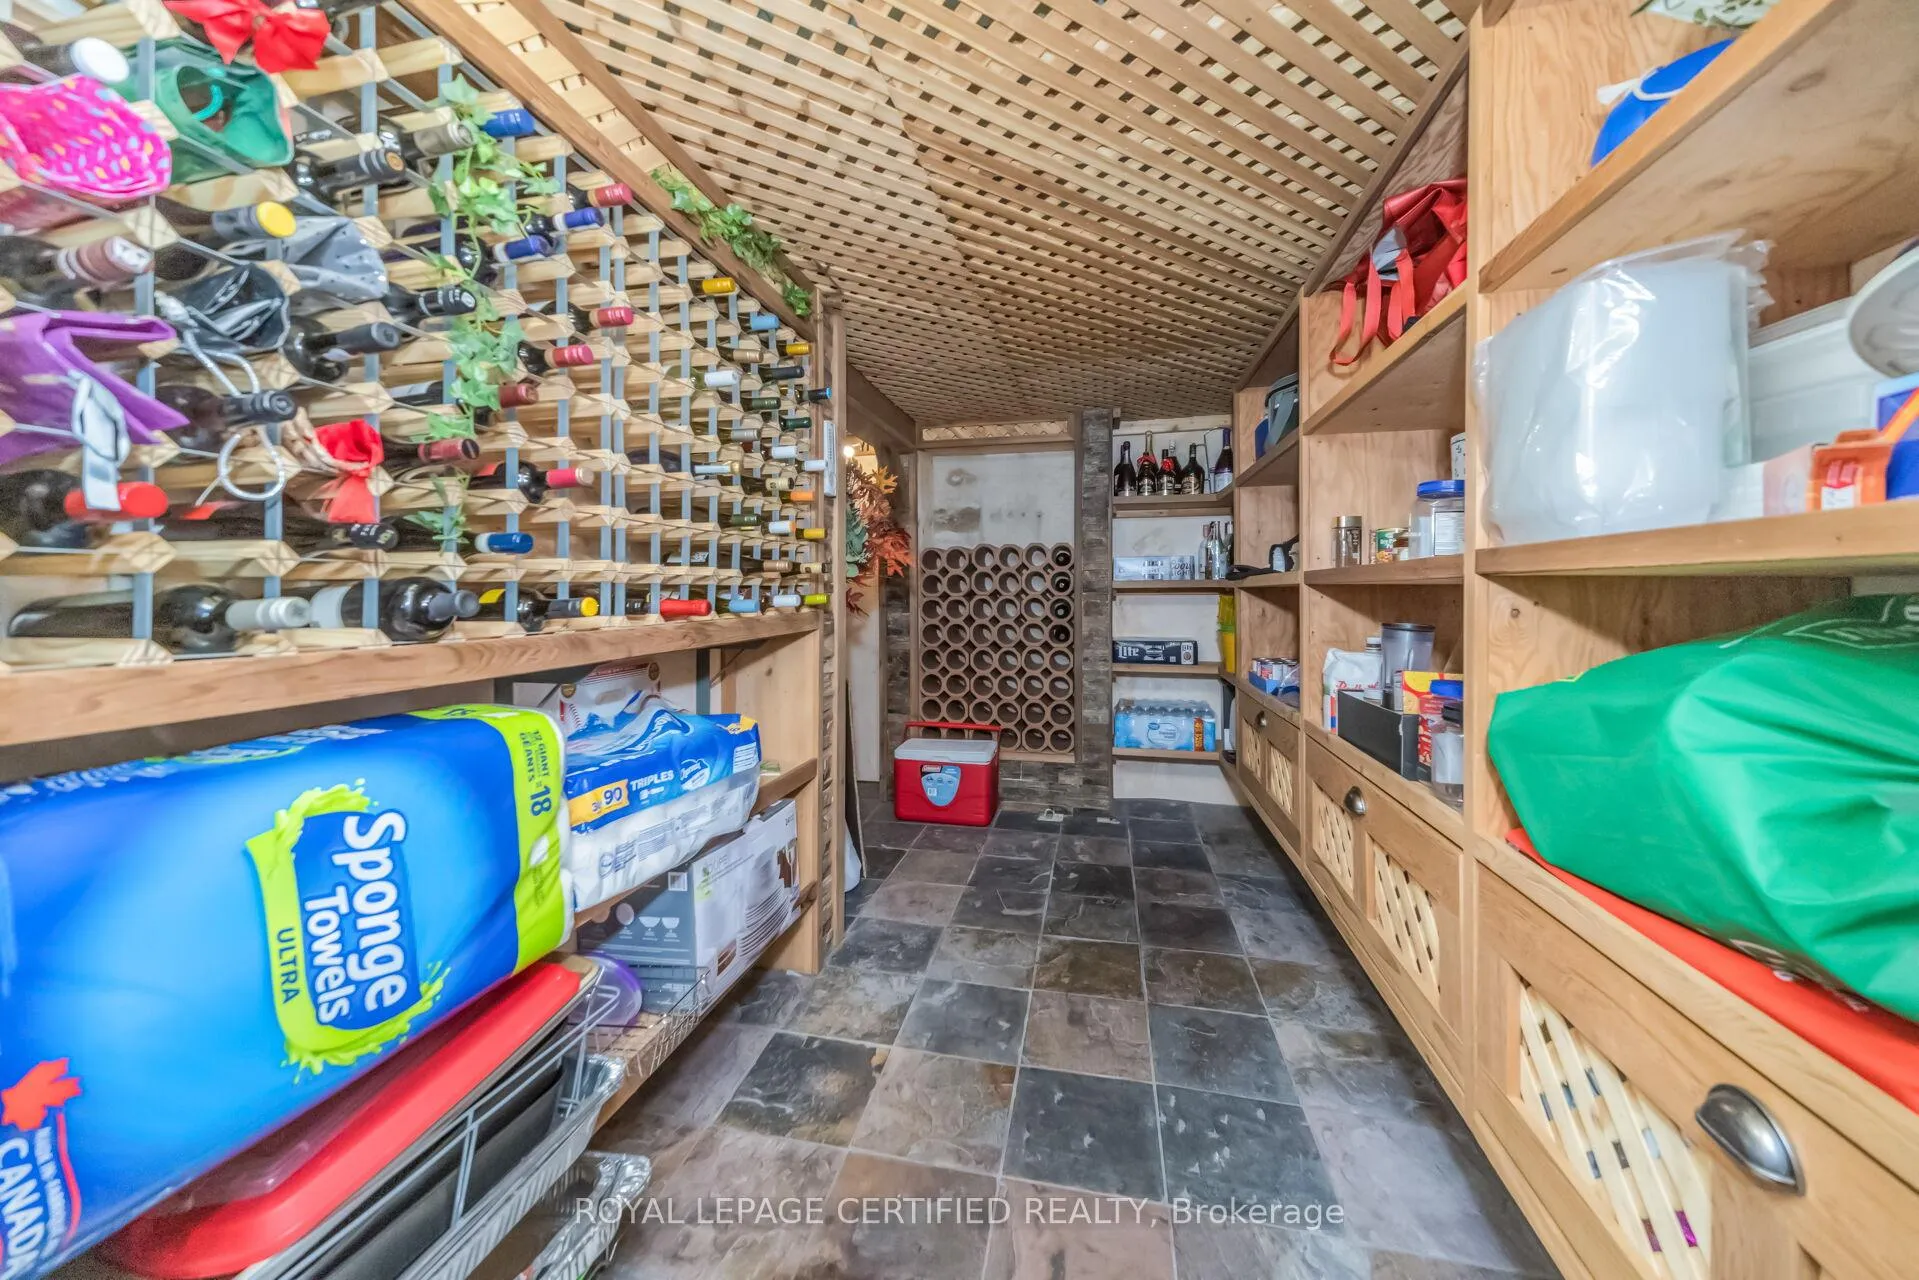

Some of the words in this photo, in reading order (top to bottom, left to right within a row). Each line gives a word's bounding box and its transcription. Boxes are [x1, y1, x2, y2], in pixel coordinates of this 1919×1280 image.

[1117, 644, 1140, 659] Lite
[539, 743, 550, 777] GIANT
[603, 786, 623, 805] 90
[630, 769, 674, 792] TRIPLES
[530, 785, 552, 816] 18
[331, 811, 408, 1012] Sponge
[276, 927, 301, 1004] ULTRA
[304, 885, 357, 1024] Towels
[0, 1137, 45, 1279] CANADA
